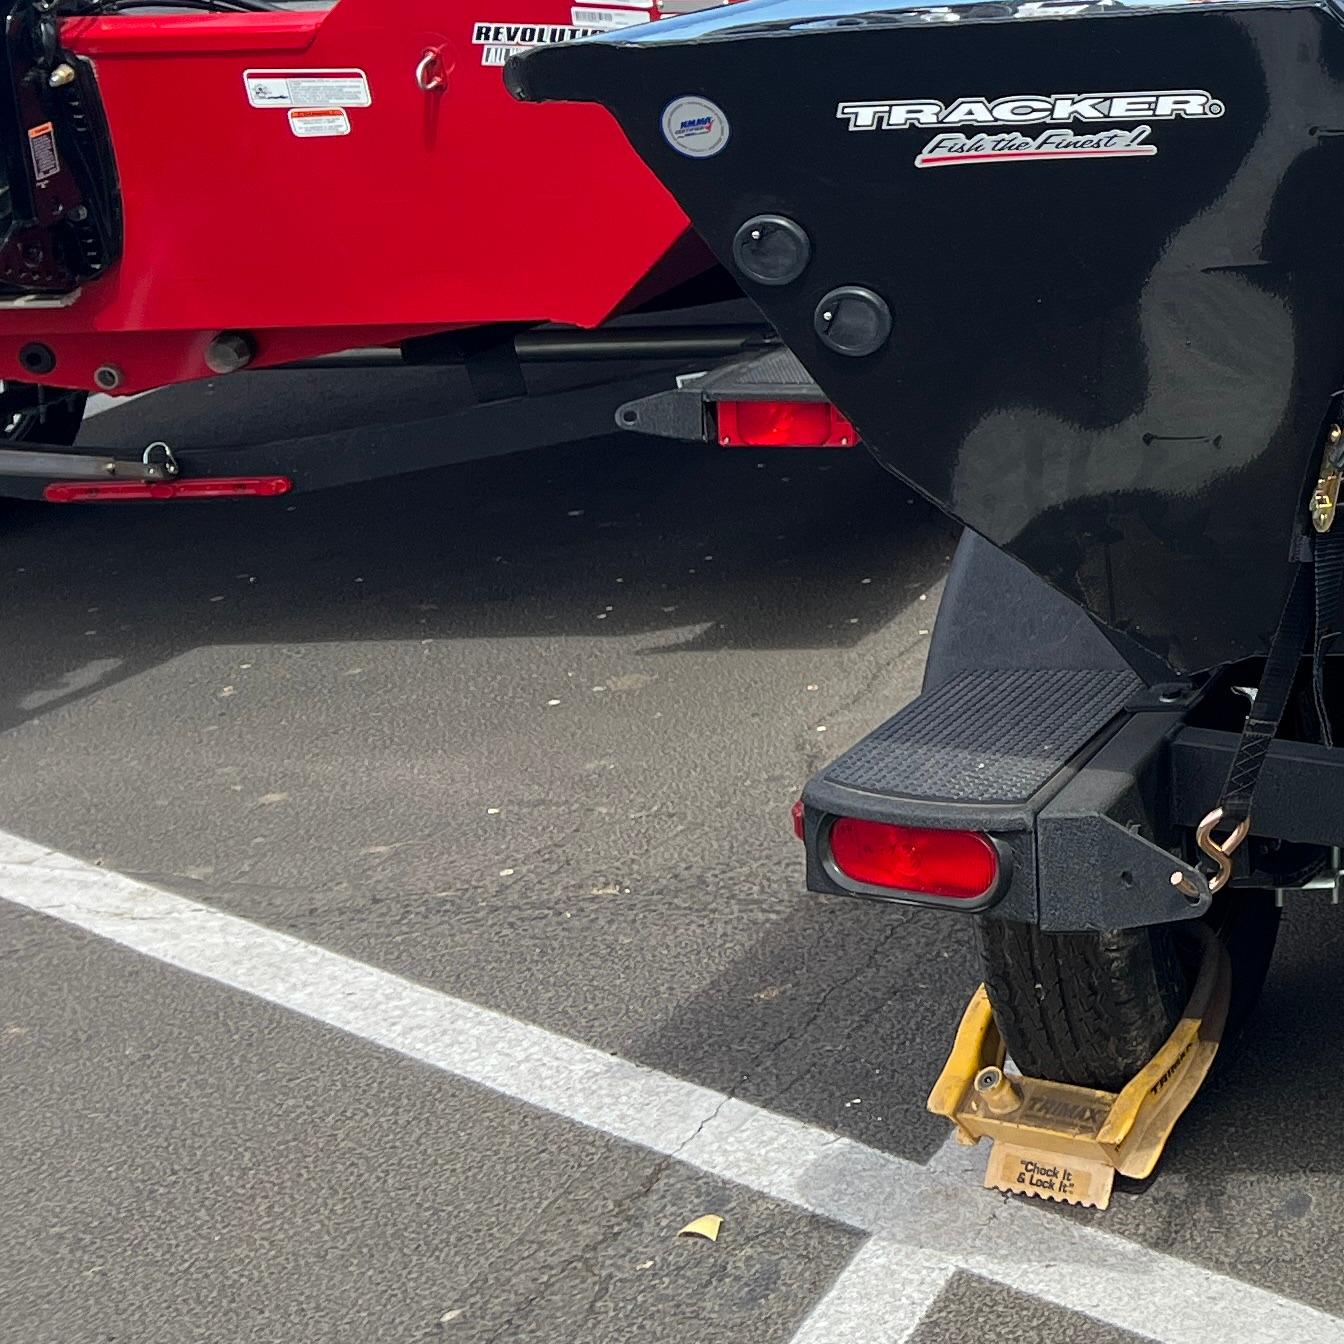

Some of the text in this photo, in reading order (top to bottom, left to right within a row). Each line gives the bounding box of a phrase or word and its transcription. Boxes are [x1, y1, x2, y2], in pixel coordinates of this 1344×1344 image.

[842, 93, 1209, 128] TRACKER
[930, 136, 985, 155] Fish
[990, 133, 1031, 153] the
[1029, 1174, 1055, 1190] Lock
[1063, 1169, 1072, 1181] It
